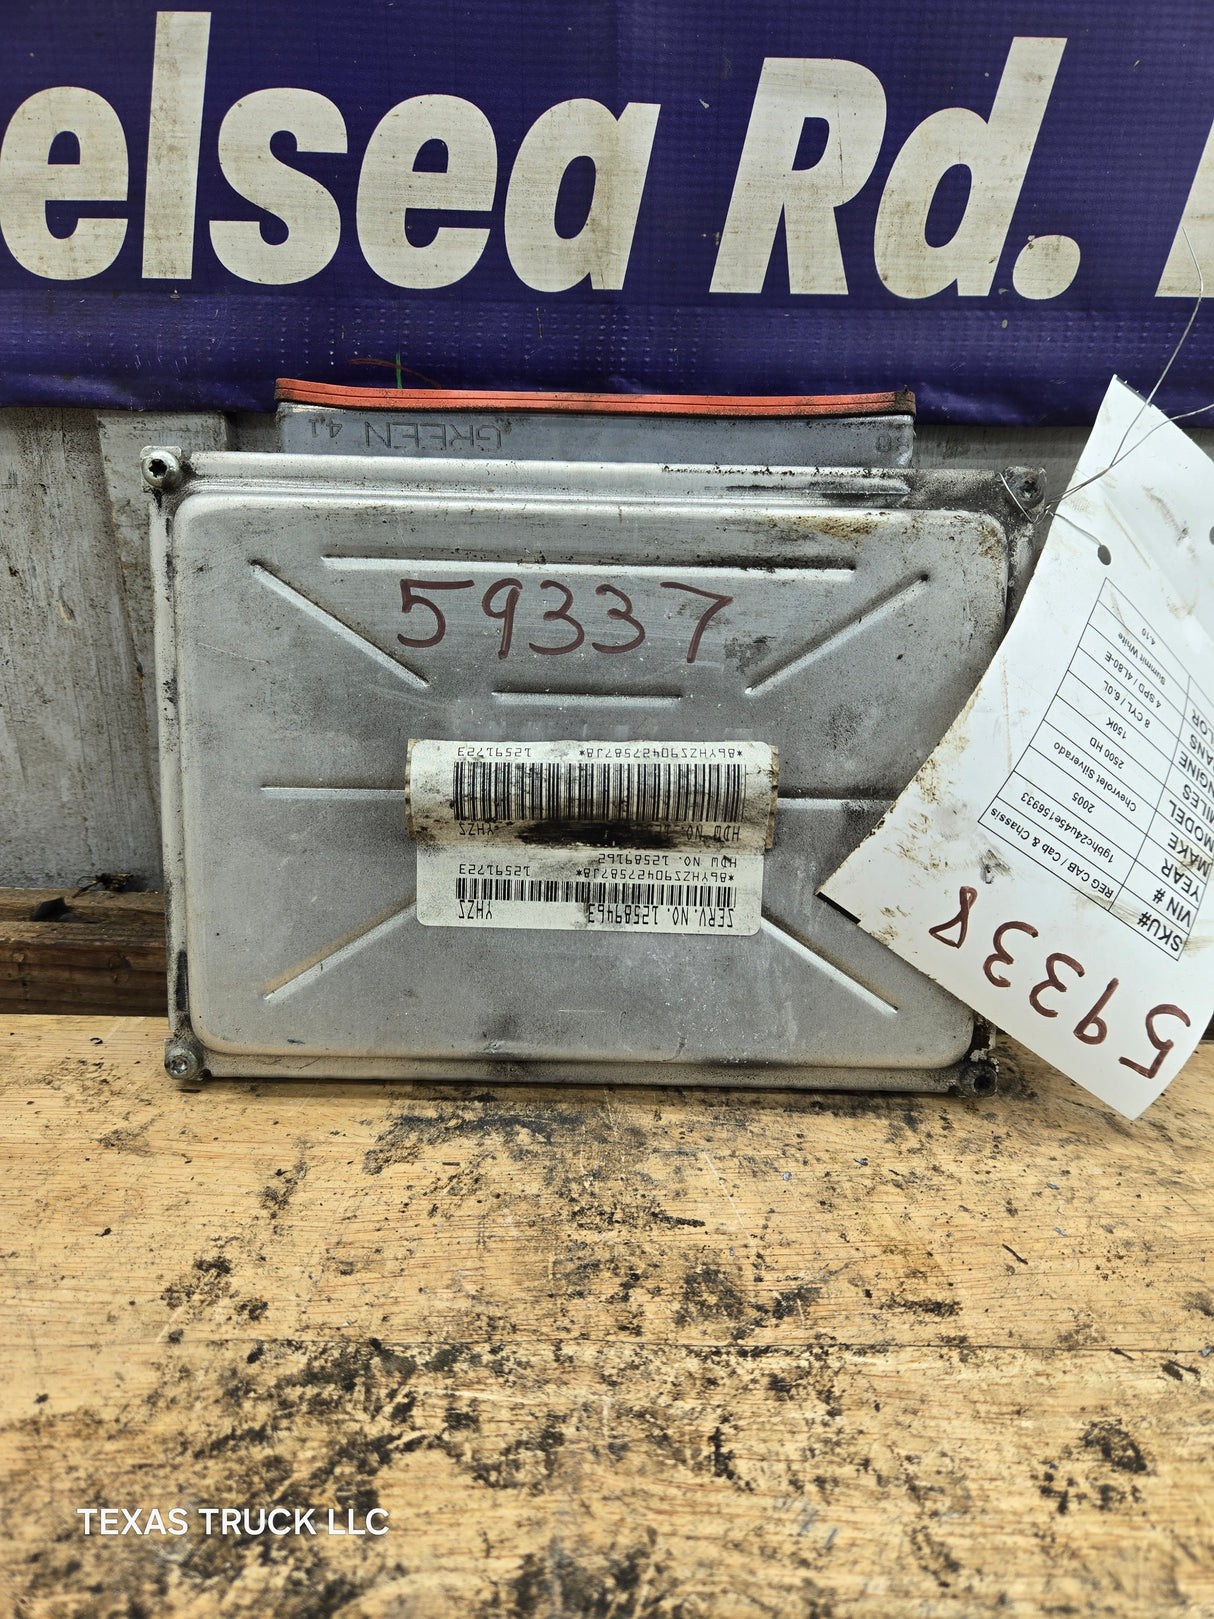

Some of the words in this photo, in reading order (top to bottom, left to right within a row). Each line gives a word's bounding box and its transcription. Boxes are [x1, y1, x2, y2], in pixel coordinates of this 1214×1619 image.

[0, 11, 661, 292] elsea
[709, 36, 1081, 299] Rd.
[364, 420, 502, 450] GREEN
[397, 577, 733, 663] 59337
[1118, 632, 1139, 658] White
[1104, 650, 1133, 681] 4L80-E
[1139, 654, 1166, 685] Summit
[1103, 680, 1121, 701] 6.0L
[1138, 683, 1156, 704] SPD
[1127, 701, 1144, 722] CYL
[1105, 717, 1127, 740] 150K
[1144, 719, 1151, 729] 8
[457, 747, 532, 758] 12591723
[1089, 736, 1104, 753] HD
[1190, 734, 1214, 770] ANS
[1054, 742, 1096, 779] Silverado
[1104, 749, 1125, 770] 2500
[1071, 792, 1096, 814] 2005
[1096, 776, 1137, 812] Chevrolet
[990, 808, 1030, 840] Chassis
[1020, 792, 1114, 863] 1gbhc24u45e156933
[1169, 799, 1214, 853] MODEL
[1031, 837, 1041, 847] &
[1041, 843, 1062, 862] Cab
[599, 854, 669, 866] 12589162
[677, 856, 700, 867] NO.
[711, 856, 737, 869] HDW
[1167, 832, 1213, 878] MAKE
[458, 864, 531, 877] 12591723
[1067, 862, 1090, 882] CAB
[1161, 858, 1200, 903] YEAR
[1090, 878, 1115, 899] REG
[1152, 888, 1166, 904] #
[458, 900, 493, 919] YHZS
[587, 903, 659, 924] 12589463
[1166, 897, 1191, 928] VIN
[1137, 911, 1183, 952] SKU#
[929, 886, 1191, 1079] 59338
